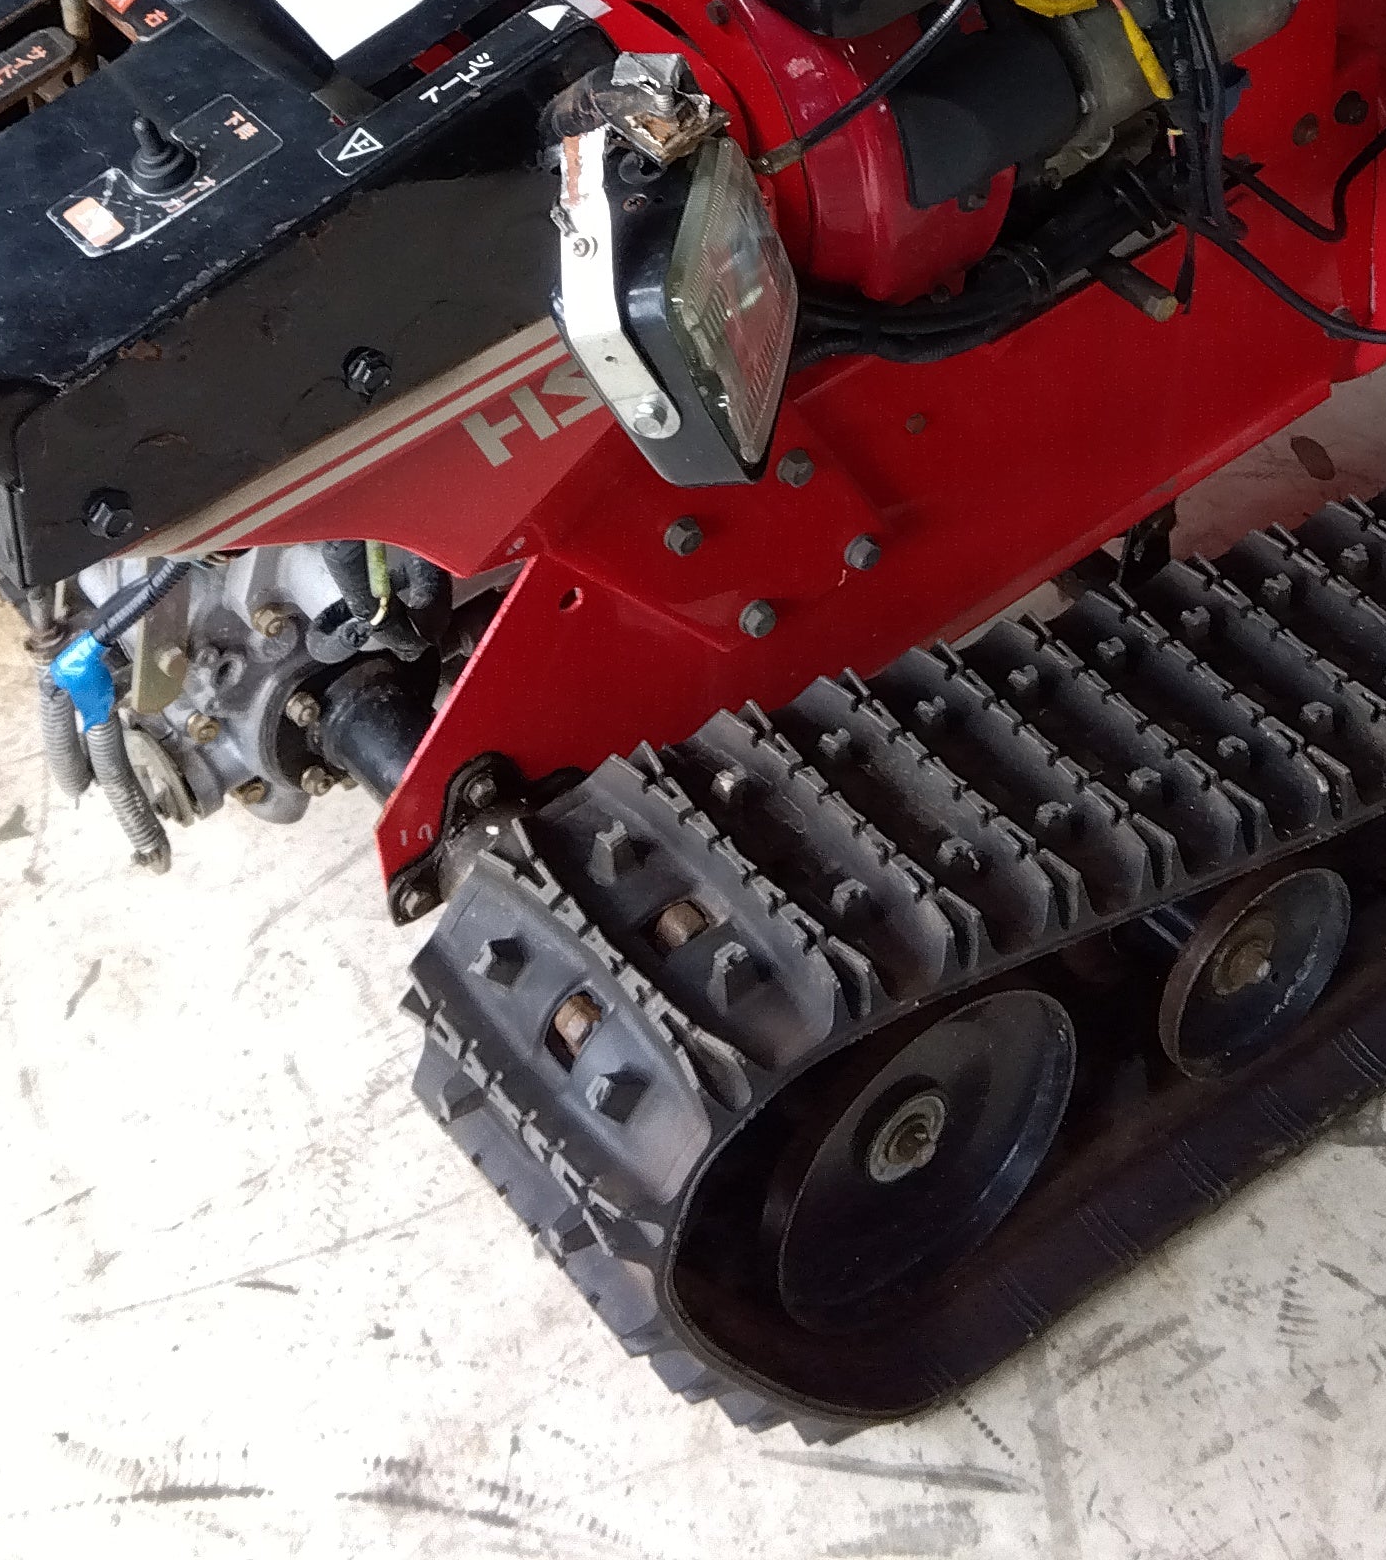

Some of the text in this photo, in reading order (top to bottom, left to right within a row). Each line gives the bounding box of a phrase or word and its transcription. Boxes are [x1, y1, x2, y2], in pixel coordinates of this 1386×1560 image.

[144, 8, 169, 28] 右
[418, 52, 495, 104] シュート
